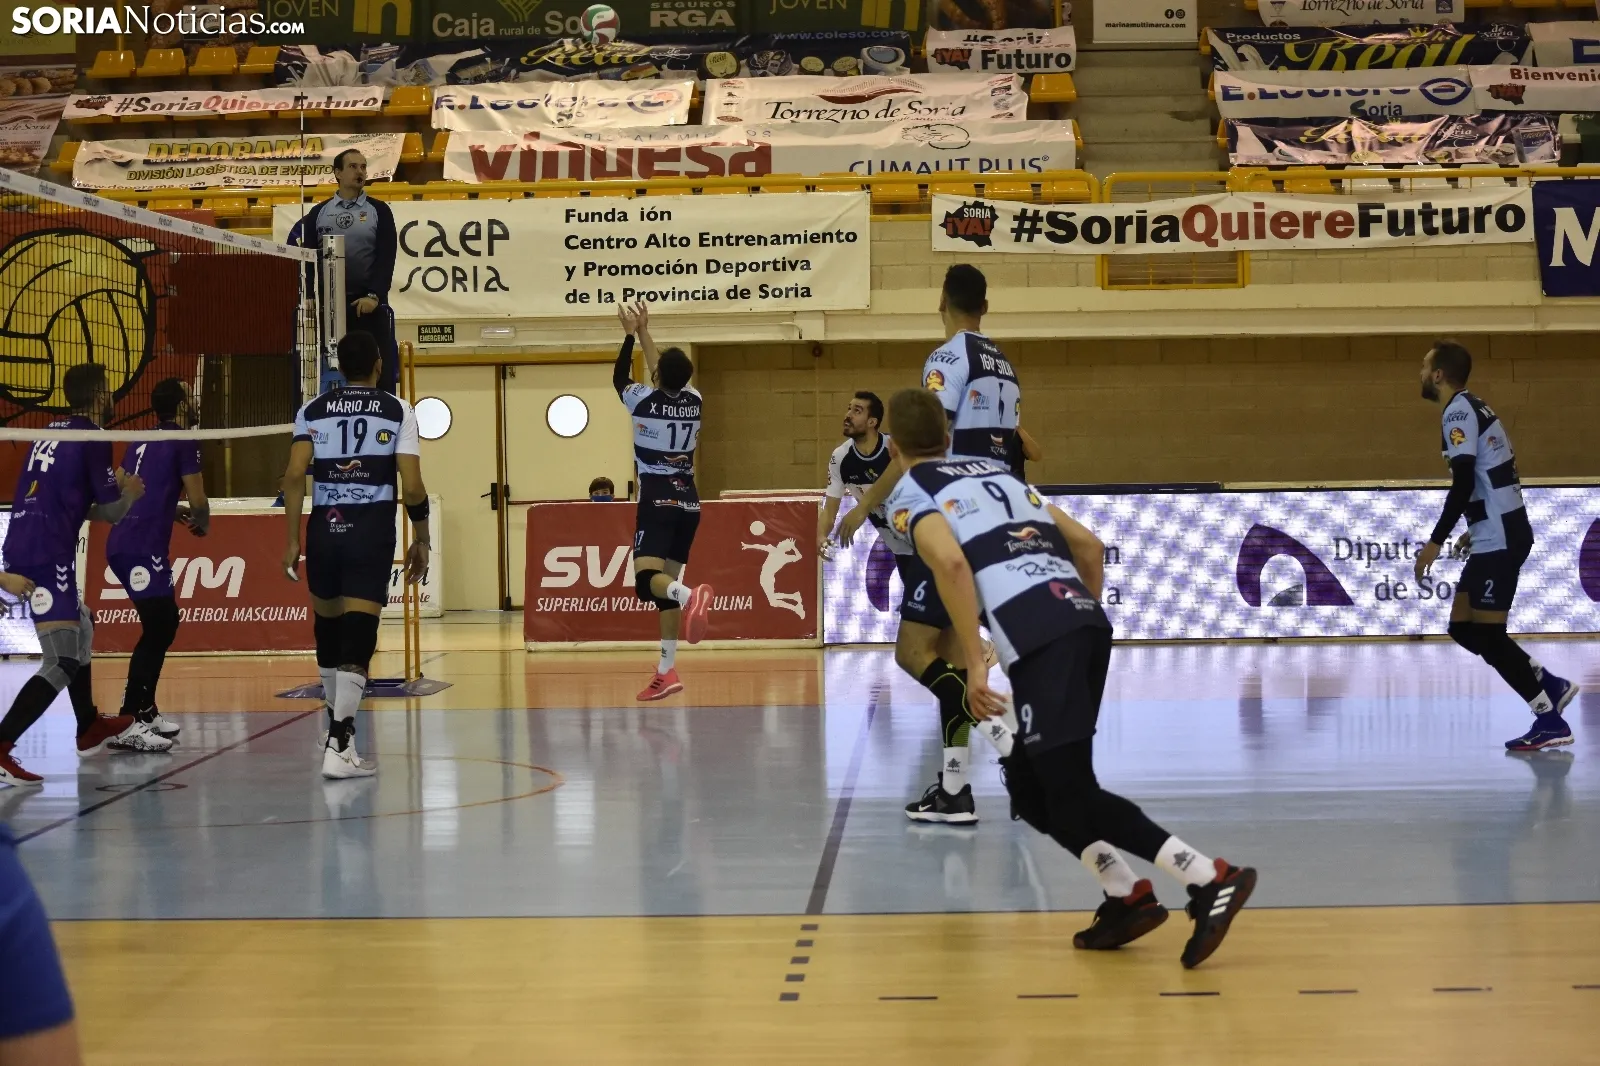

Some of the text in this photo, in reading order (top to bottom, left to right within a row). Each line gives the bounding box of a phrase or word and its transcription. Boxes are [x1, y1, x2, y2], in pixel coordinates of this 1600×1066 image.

[432, 13, 495, 39] Caja
[500, 26, 524, 35] rural
[527, 26, 541, 35] de
[651, 10, 735, 27] RGA
[981, 50, 1072, 70] Futuro
[766, 101, 869, 123] Torrezno
[875, 99, 900, 119] de
[1350, 99, 1403, 117] Soria
[126, 163, 334, 181] DIVISIÓN LOGÍSTICA DE EVENTO
[963, 207, 991, 218] SORIA
[1010, 202, 1526, 247] #SoriaQuiereFuturo
[564, 228, 858, 250] Centro Alto Entrenamiento
[564, 256, 812, 281] y Promoción Deportiva
[565, 282, 812, 304] de la Provincia de Soria
[421, 326, 441, 334] SALIDA
[326, 398, 383, 413] MÁRIO JR.
[649, 402, 659, 415] X.
[337, 417, 367, 455] 19
[667, 422, 694, 450] 17
[981, 481, 1014, 519] 9
[913, 580, 927, 601] 6
[1375, 575, 1408, 601] de
[1484, 580, 1494, 598] 2
[178, 607, 229, 622] OLEIBOL
[231, 606, 308, 622] MASCULINA
[536, 596, 607, 612] SUPERLIGA
[1021, 703, 1033, 734] 9
